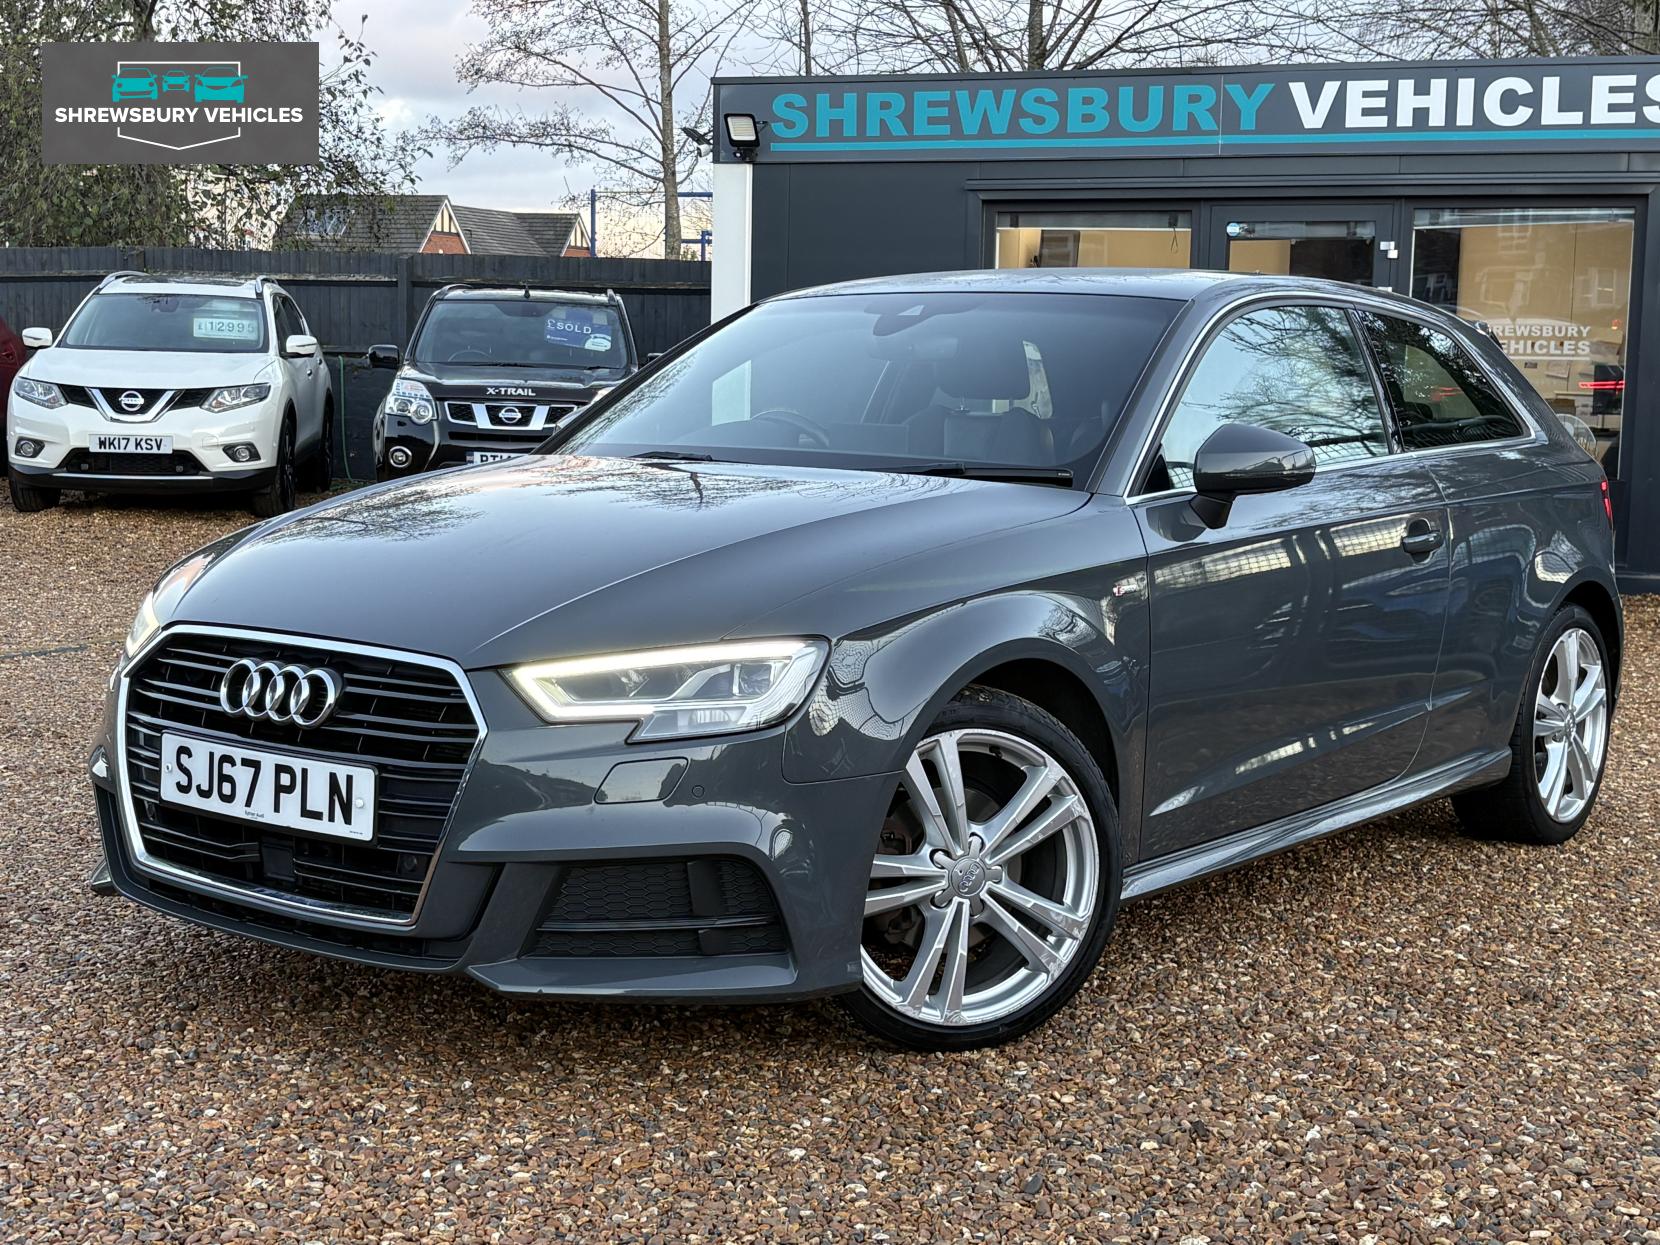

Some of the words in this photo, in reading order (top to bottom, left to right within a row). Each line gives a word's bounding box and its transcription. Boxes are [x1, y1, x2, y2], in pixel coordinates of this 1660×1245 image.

[771, 83, 1276, 138] SHREWSBURY
[1492, 325, 1591, 337] REWSBURY
[1501, 340, 1591, 355] EHICLES
[486, 387, 537, 396] X-TRAIL
[98, 436, 130, 450] WK17
[134, 437, 163, 451] KSV
[175, 745, 262, 808] SJ67
[273, 763, 354, 826] PLN
